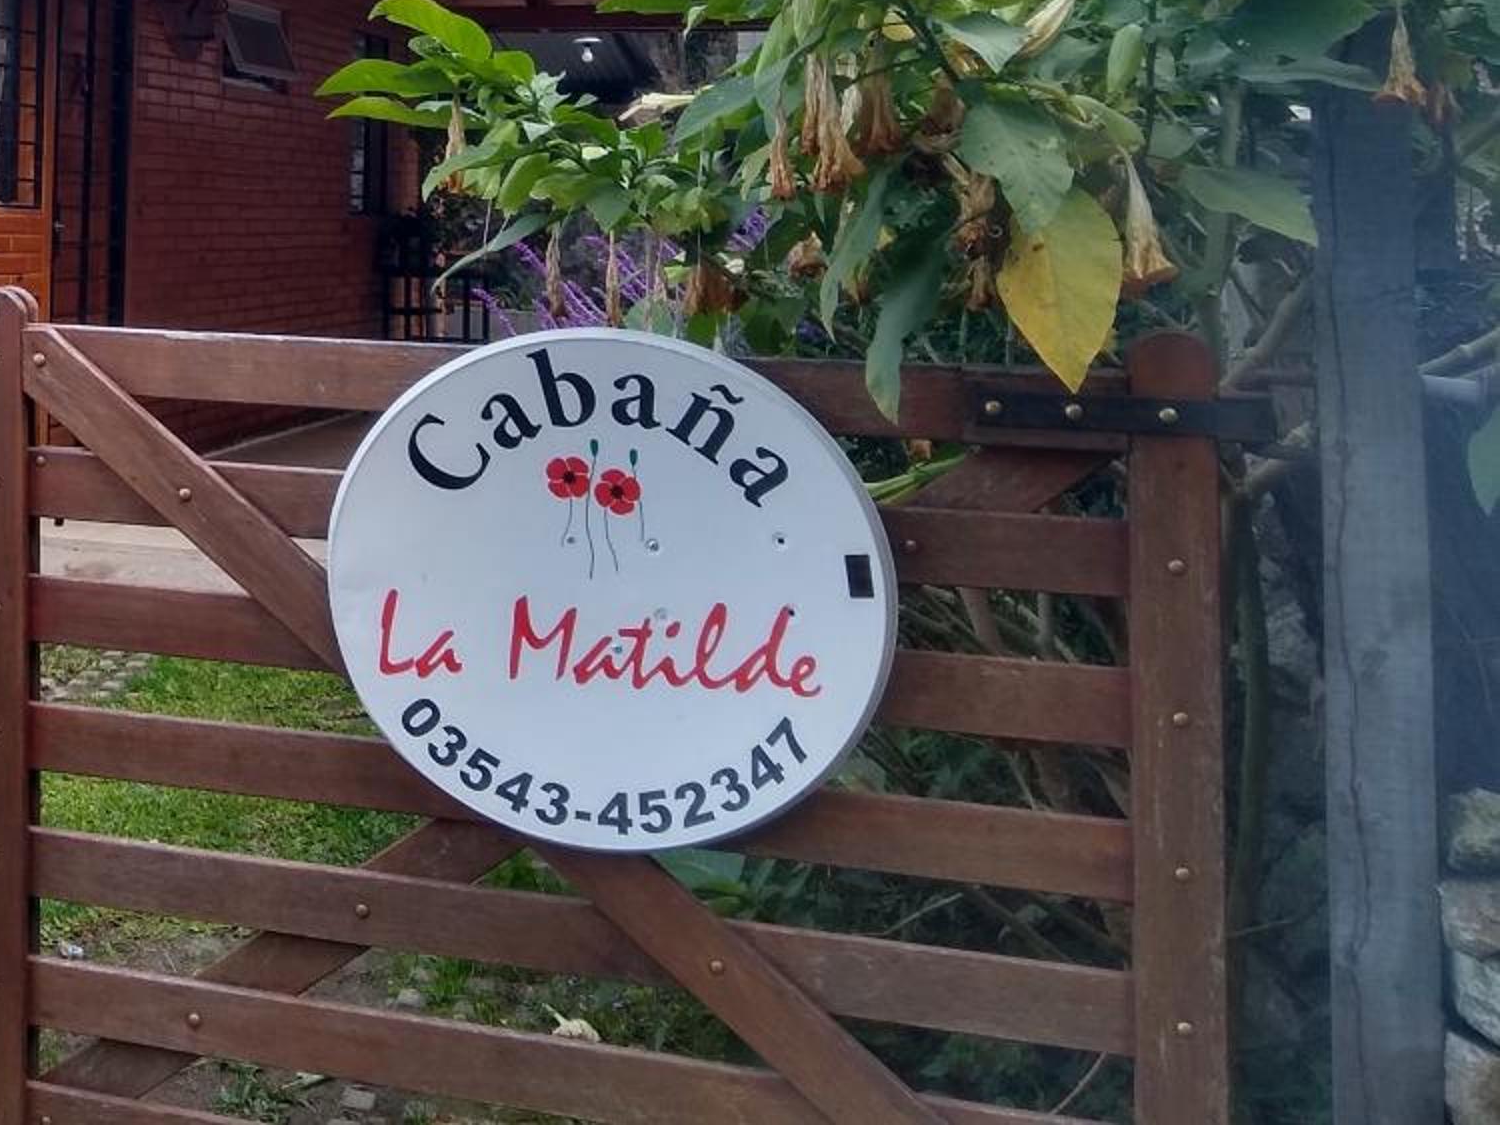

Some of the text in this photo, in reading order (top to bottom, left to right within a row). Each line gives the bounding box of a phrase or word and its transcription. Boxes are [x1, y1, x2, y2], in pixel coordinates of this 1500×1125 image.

[406, 347, 791, 508] Cabaña
[377, 588, 822, 698] La Matilde
[400, 696, 810, 837] 03543-452347
